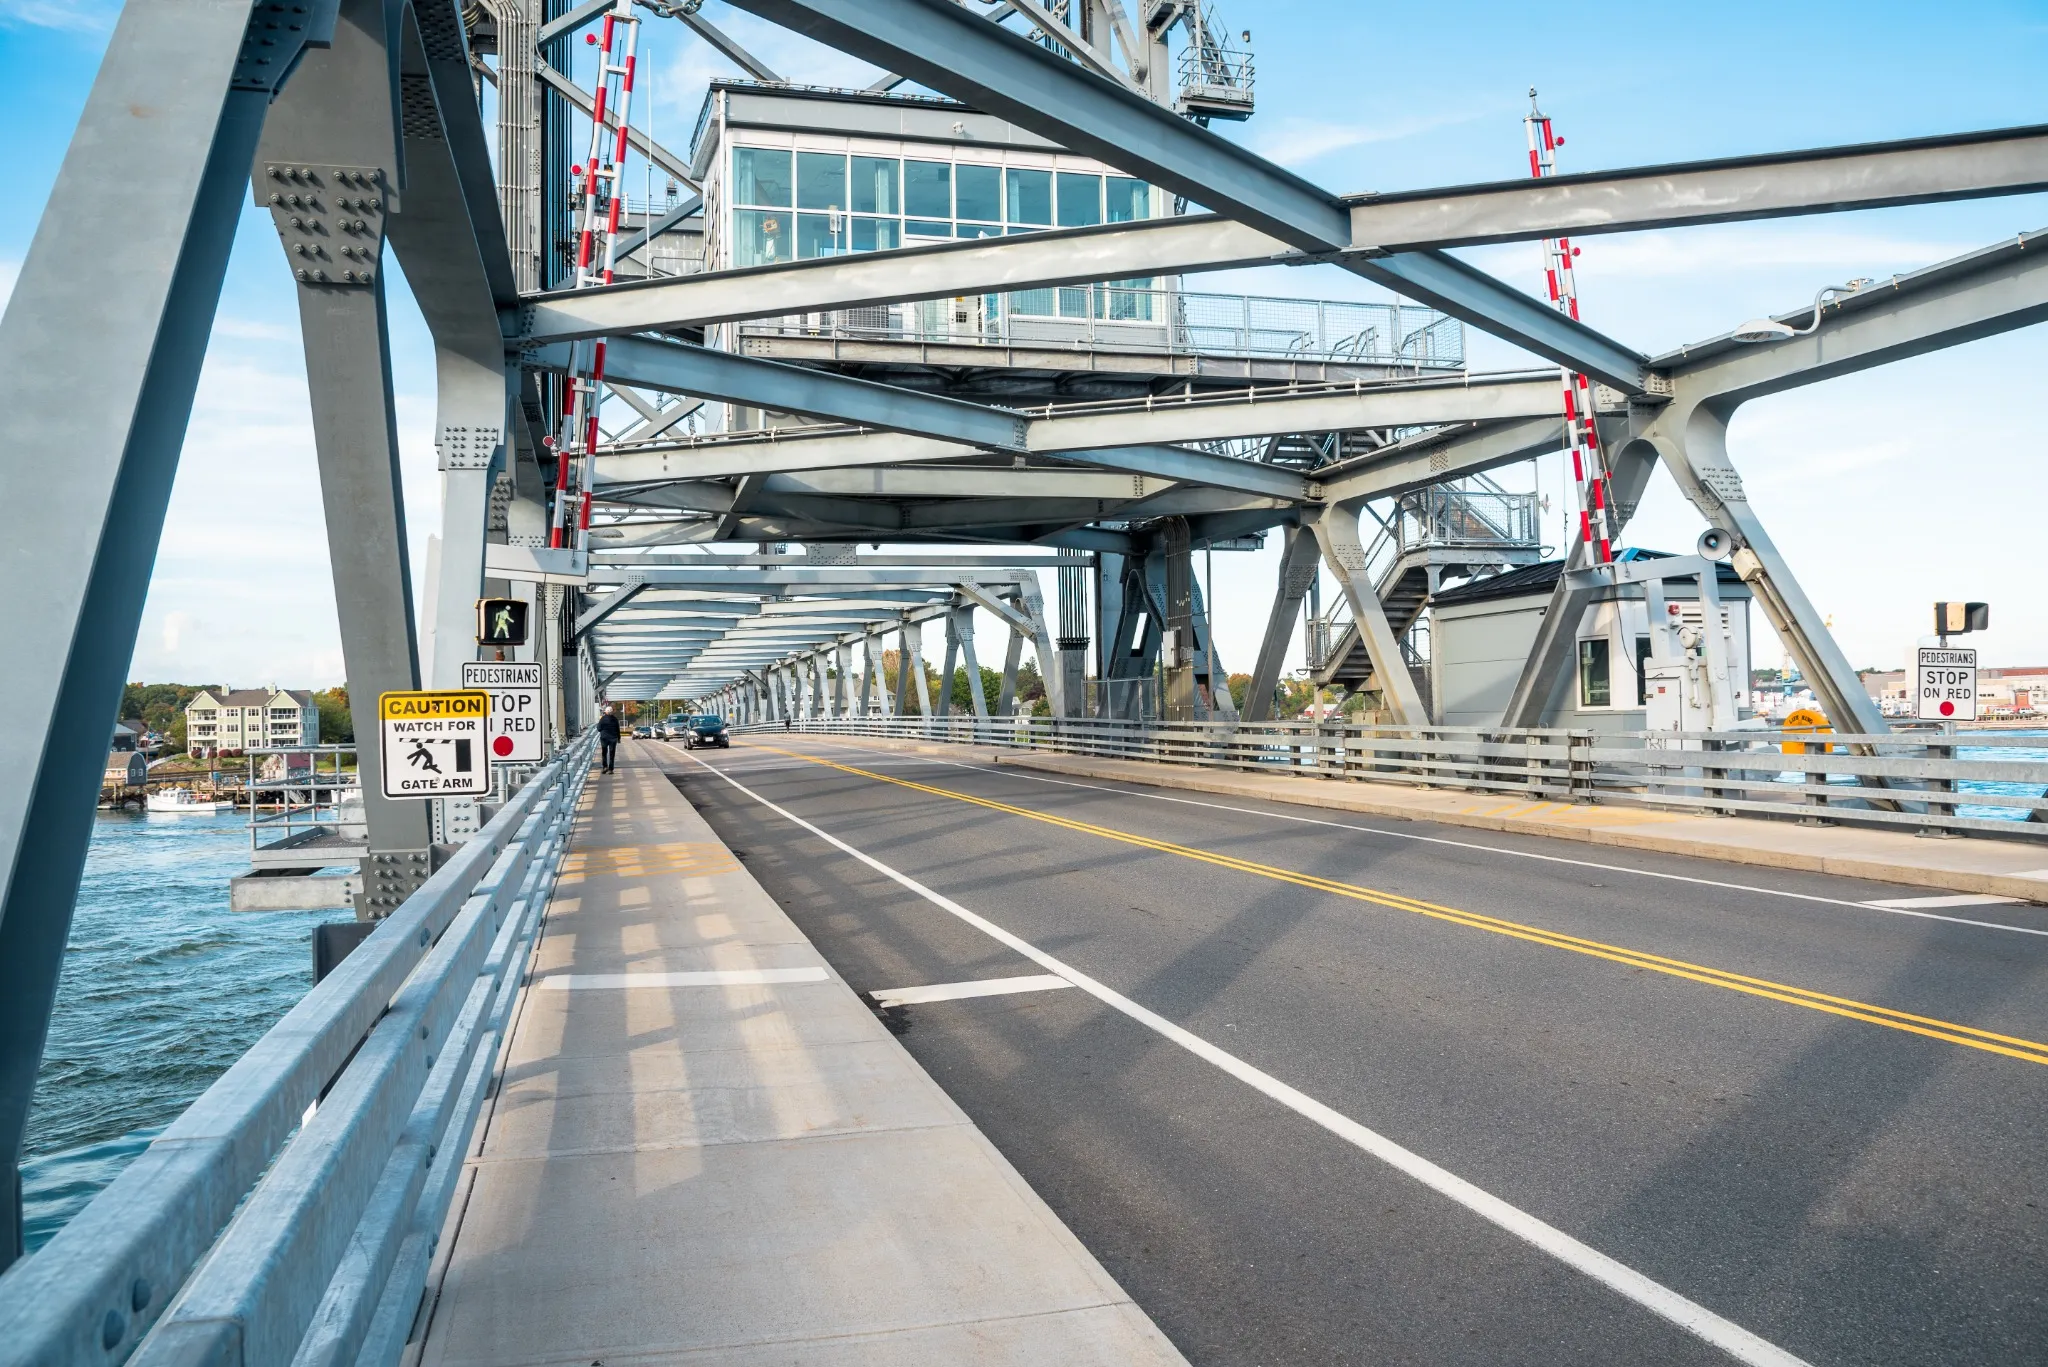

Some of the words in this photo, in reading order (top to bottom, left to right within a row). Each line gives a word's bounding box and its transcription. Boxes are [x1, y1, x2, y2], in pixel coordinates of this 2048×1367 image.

[1922, 652, 1973, 664] PEDESTRIANS
[466, 669, 539, 684] PEDESTRIANS
[1927, 671, 1968, 685] STOP
[1924, 688, 1940, 698] ON
[1947, 688, 1971, 699] RED
[389, 699, 481, 715] CAUTION
[490, 694, 531, 713] TOP
[394, 721, 443, 732] WATCH
[448, 721, 476, 731] FOR
[504, 717, 535, 732] RED
[401, 779, 440, 790] GATE
[443, 778, 473, 788] ARM
